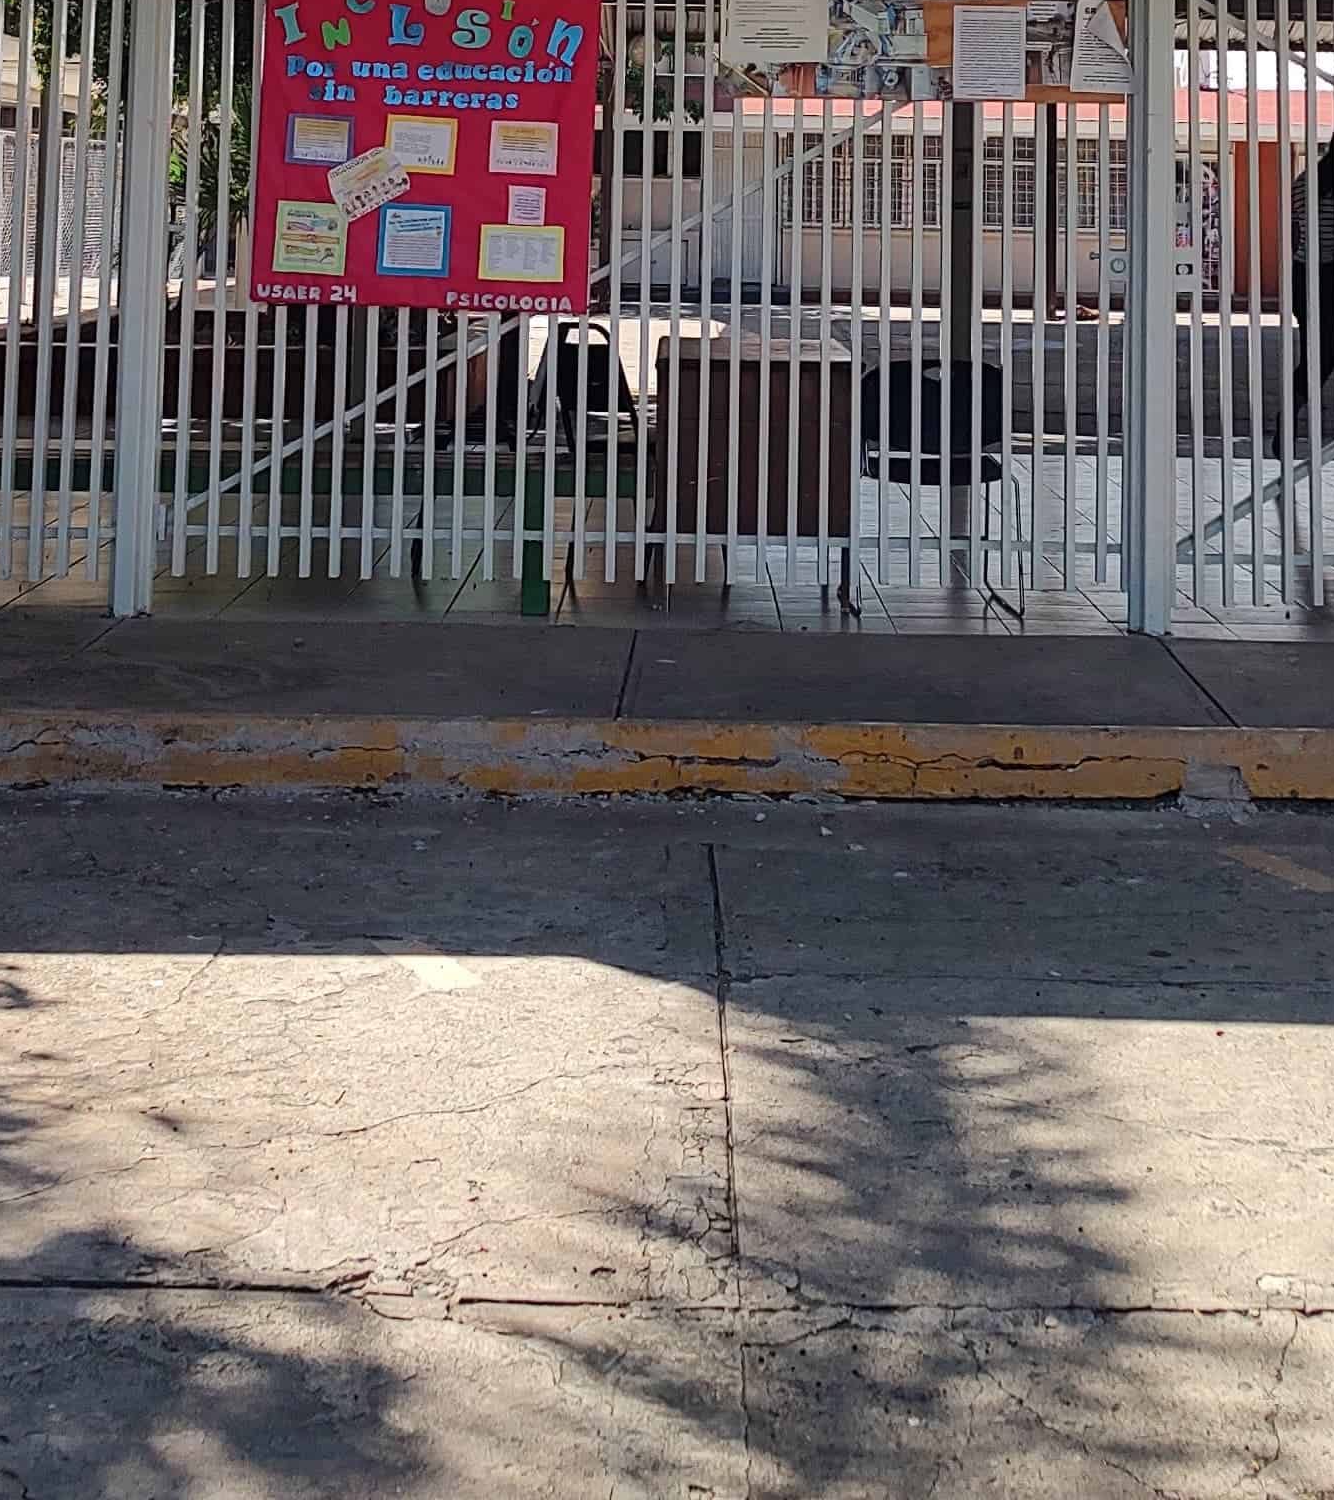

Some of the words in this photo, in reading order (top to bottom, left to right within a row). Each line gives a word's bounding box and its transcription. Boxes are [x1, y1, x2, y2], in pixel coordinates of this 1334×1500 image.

[286, 55, 335, 78] Por
[351, 60, 409, 79] una
[417, 60, 573, 83] educación
[309, 80, 356, 101] sin
[383, 85, 519, 110] barreras
[256, 283, 321, 300] USAER
[330, 285, 357, 302] 24
[445, 291, 573, 311] PSICOLOGIA
